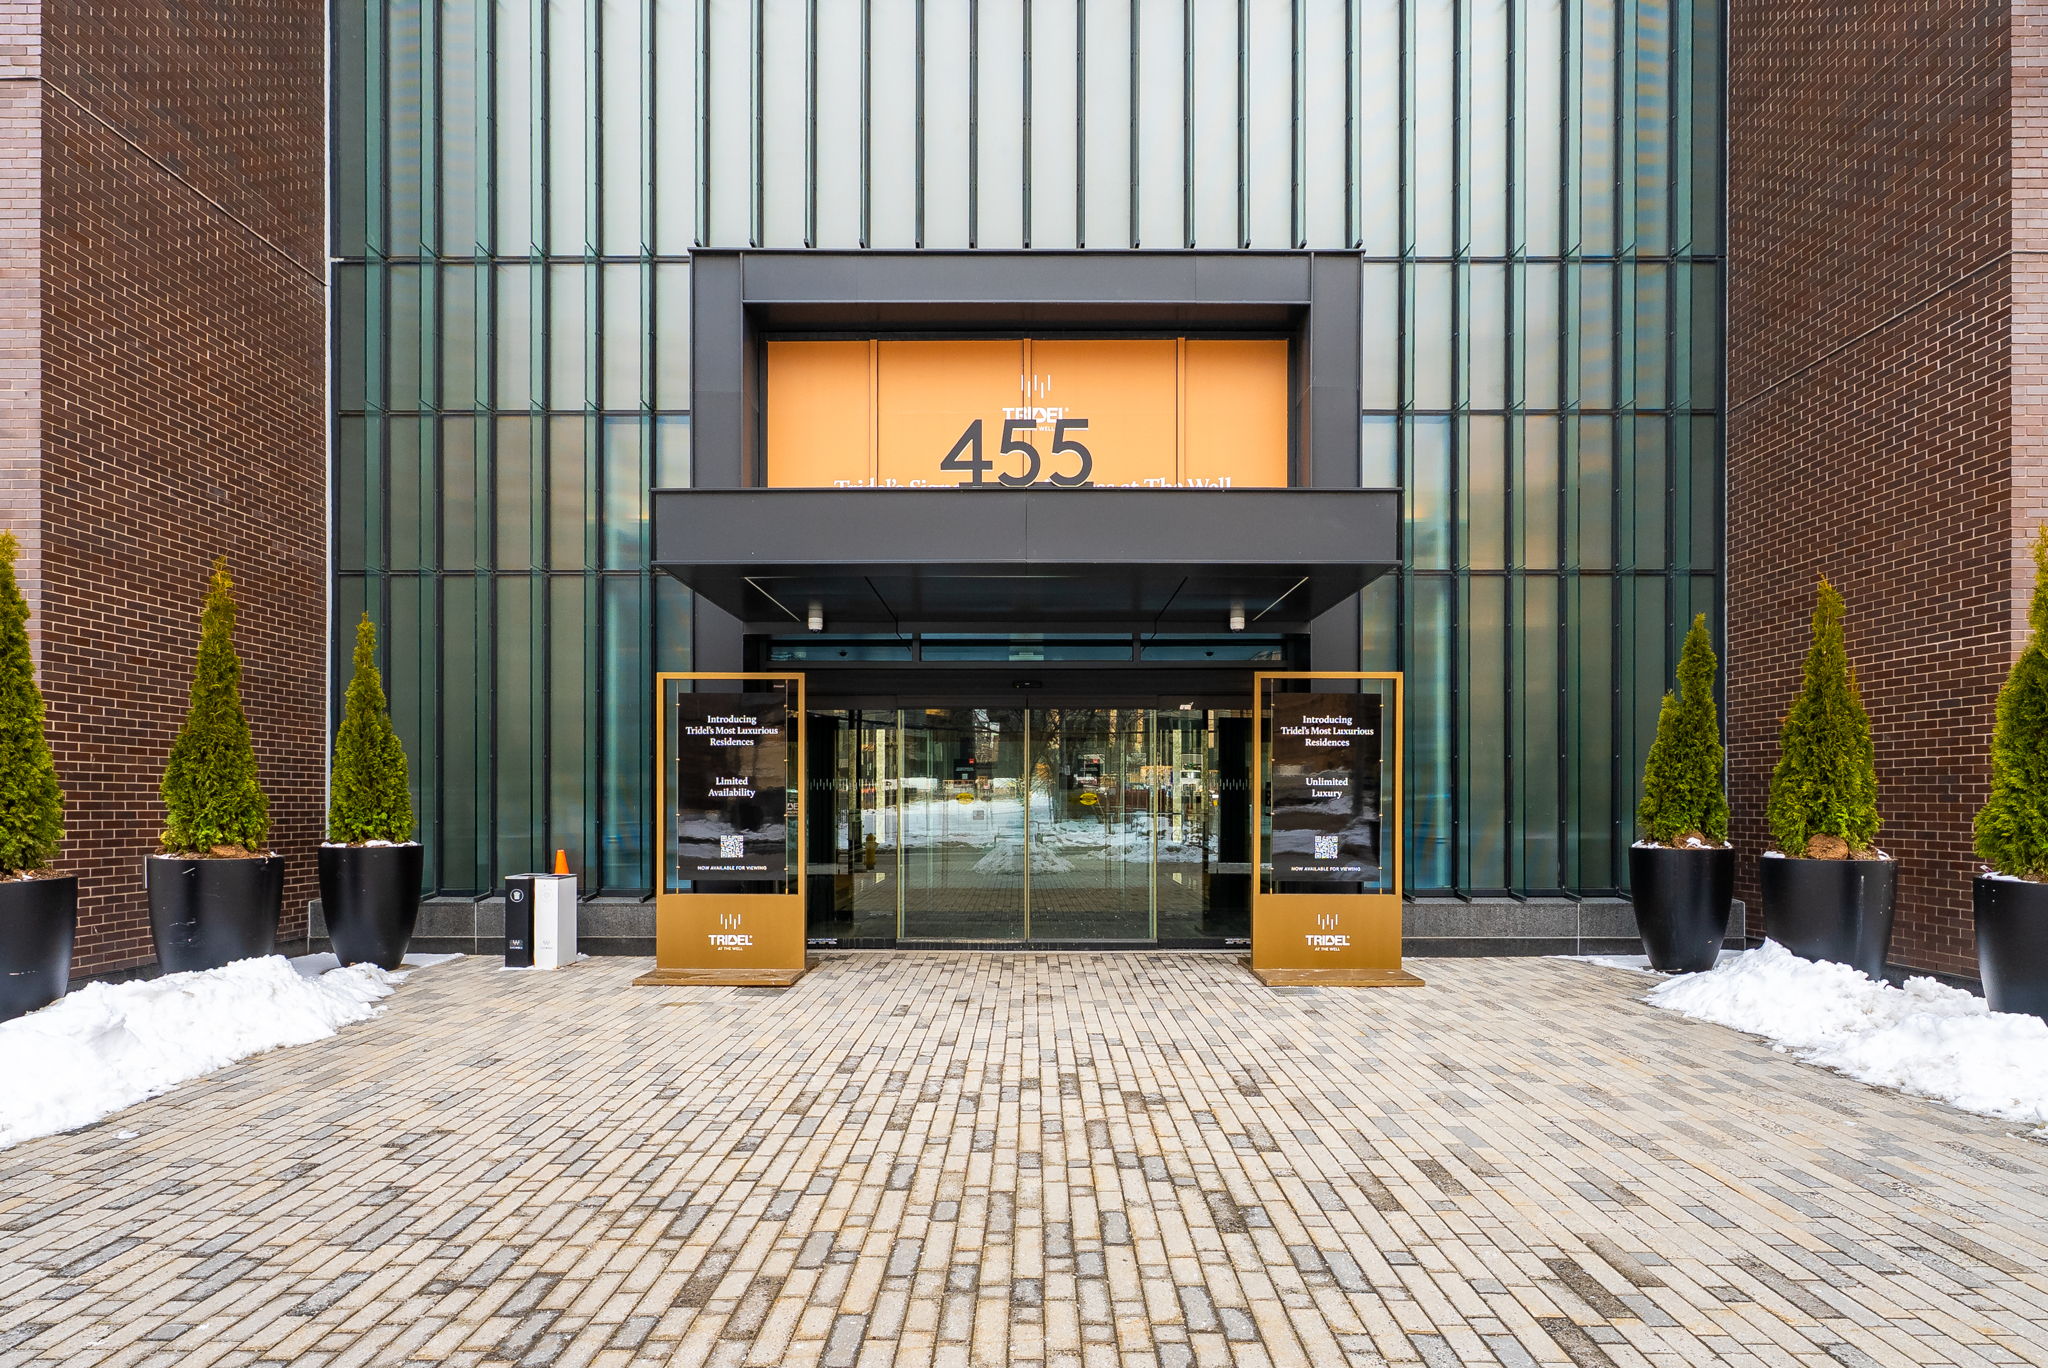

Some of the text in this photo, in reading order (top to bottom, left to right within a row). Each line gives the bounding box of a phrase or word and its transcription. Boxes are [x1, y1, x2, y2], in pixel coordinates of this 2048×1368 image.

[941, 419, 1093, 487] 455
[707, 715, 757, 725] Introducing
[1302, 715, 1352, 725] Introducing
[685, 726, 778, 735] Tridel's Most Luxurious
[1280, 726, 1374, 735] Tridel's Most Luxurious
[710, 738, 754, 746] Residences
[1305, 738, 1350, 746] Residences
[715, 777, 748, 785] Limited
[1305, 777, 1349, 786] Unlimited
[708, 788, 756, 798] Availability
[1311, 789, 1342, 799] Luxury
[708, 934, 752, 946] TRIDEL
[1305, 934, 1350, 946] TRIDEL
